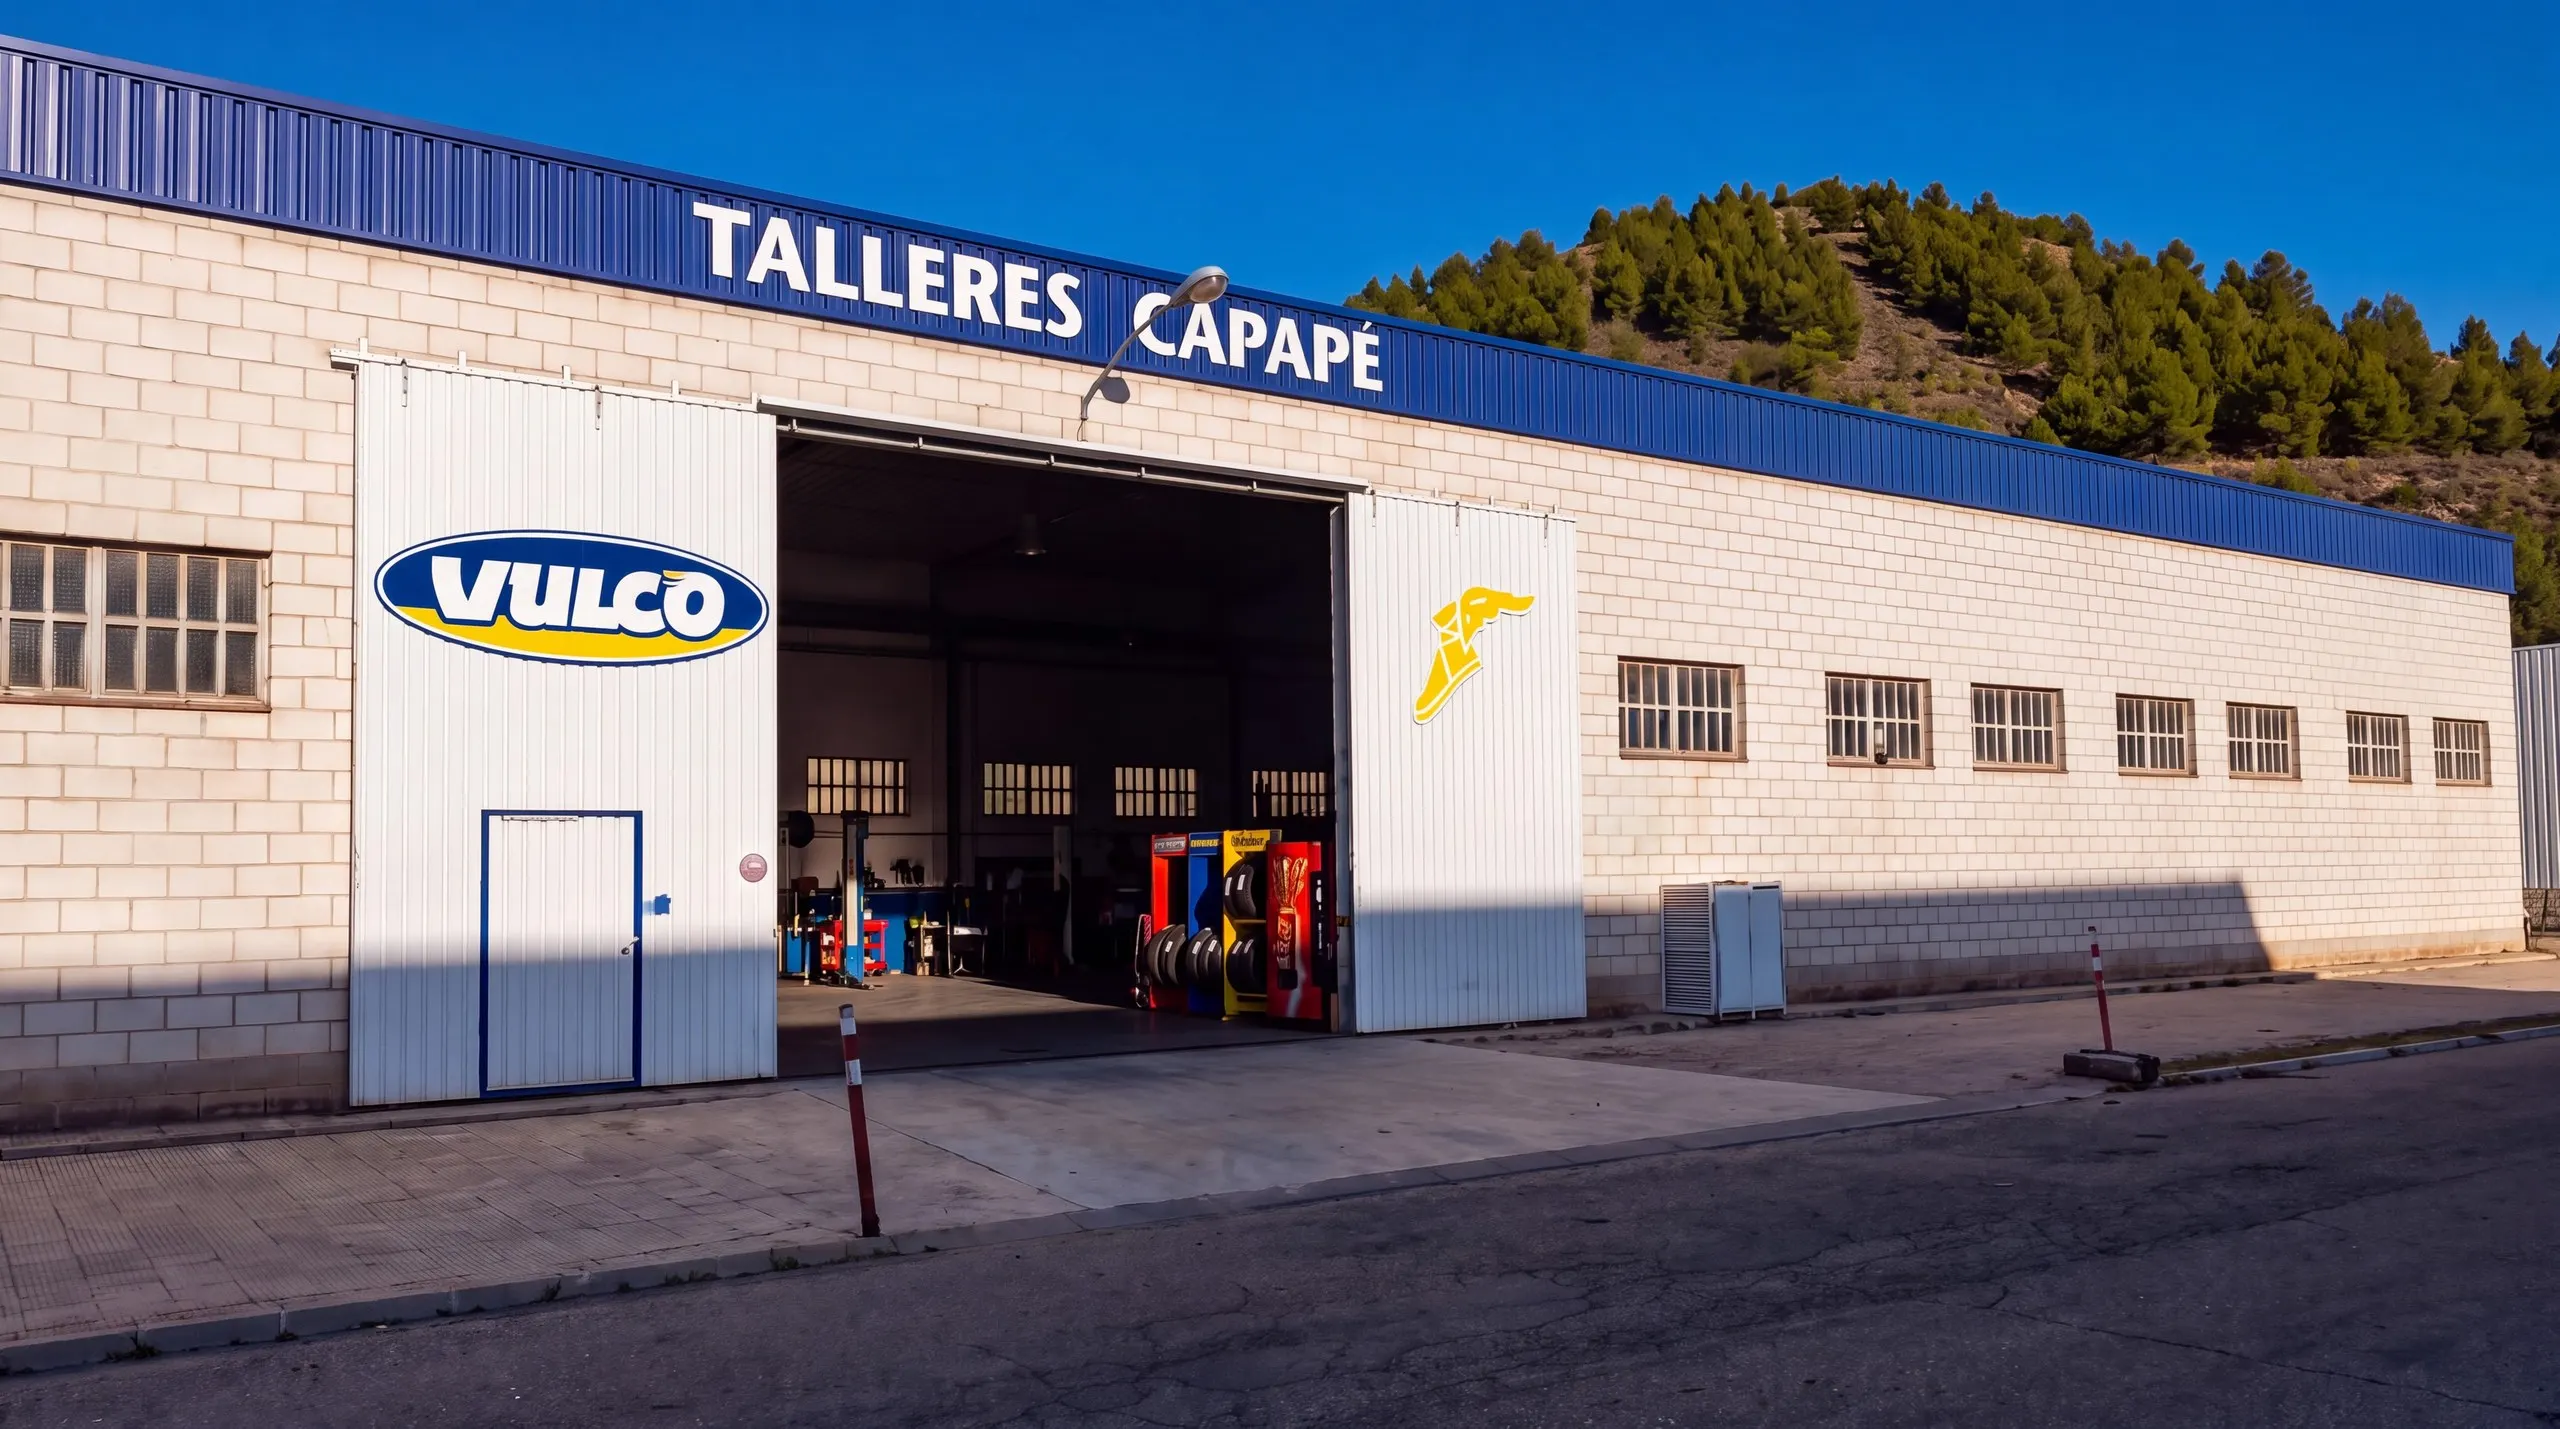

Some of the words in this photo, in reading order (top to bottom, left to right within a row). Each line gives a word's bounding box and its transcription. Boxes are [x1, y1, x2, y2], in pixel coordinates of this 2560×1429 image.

[693, 202, 1083, 338] TALLERES
[1133, 292, 1383, 391] CAPAPÉ
[431, 555, 725, 638] VULCO
